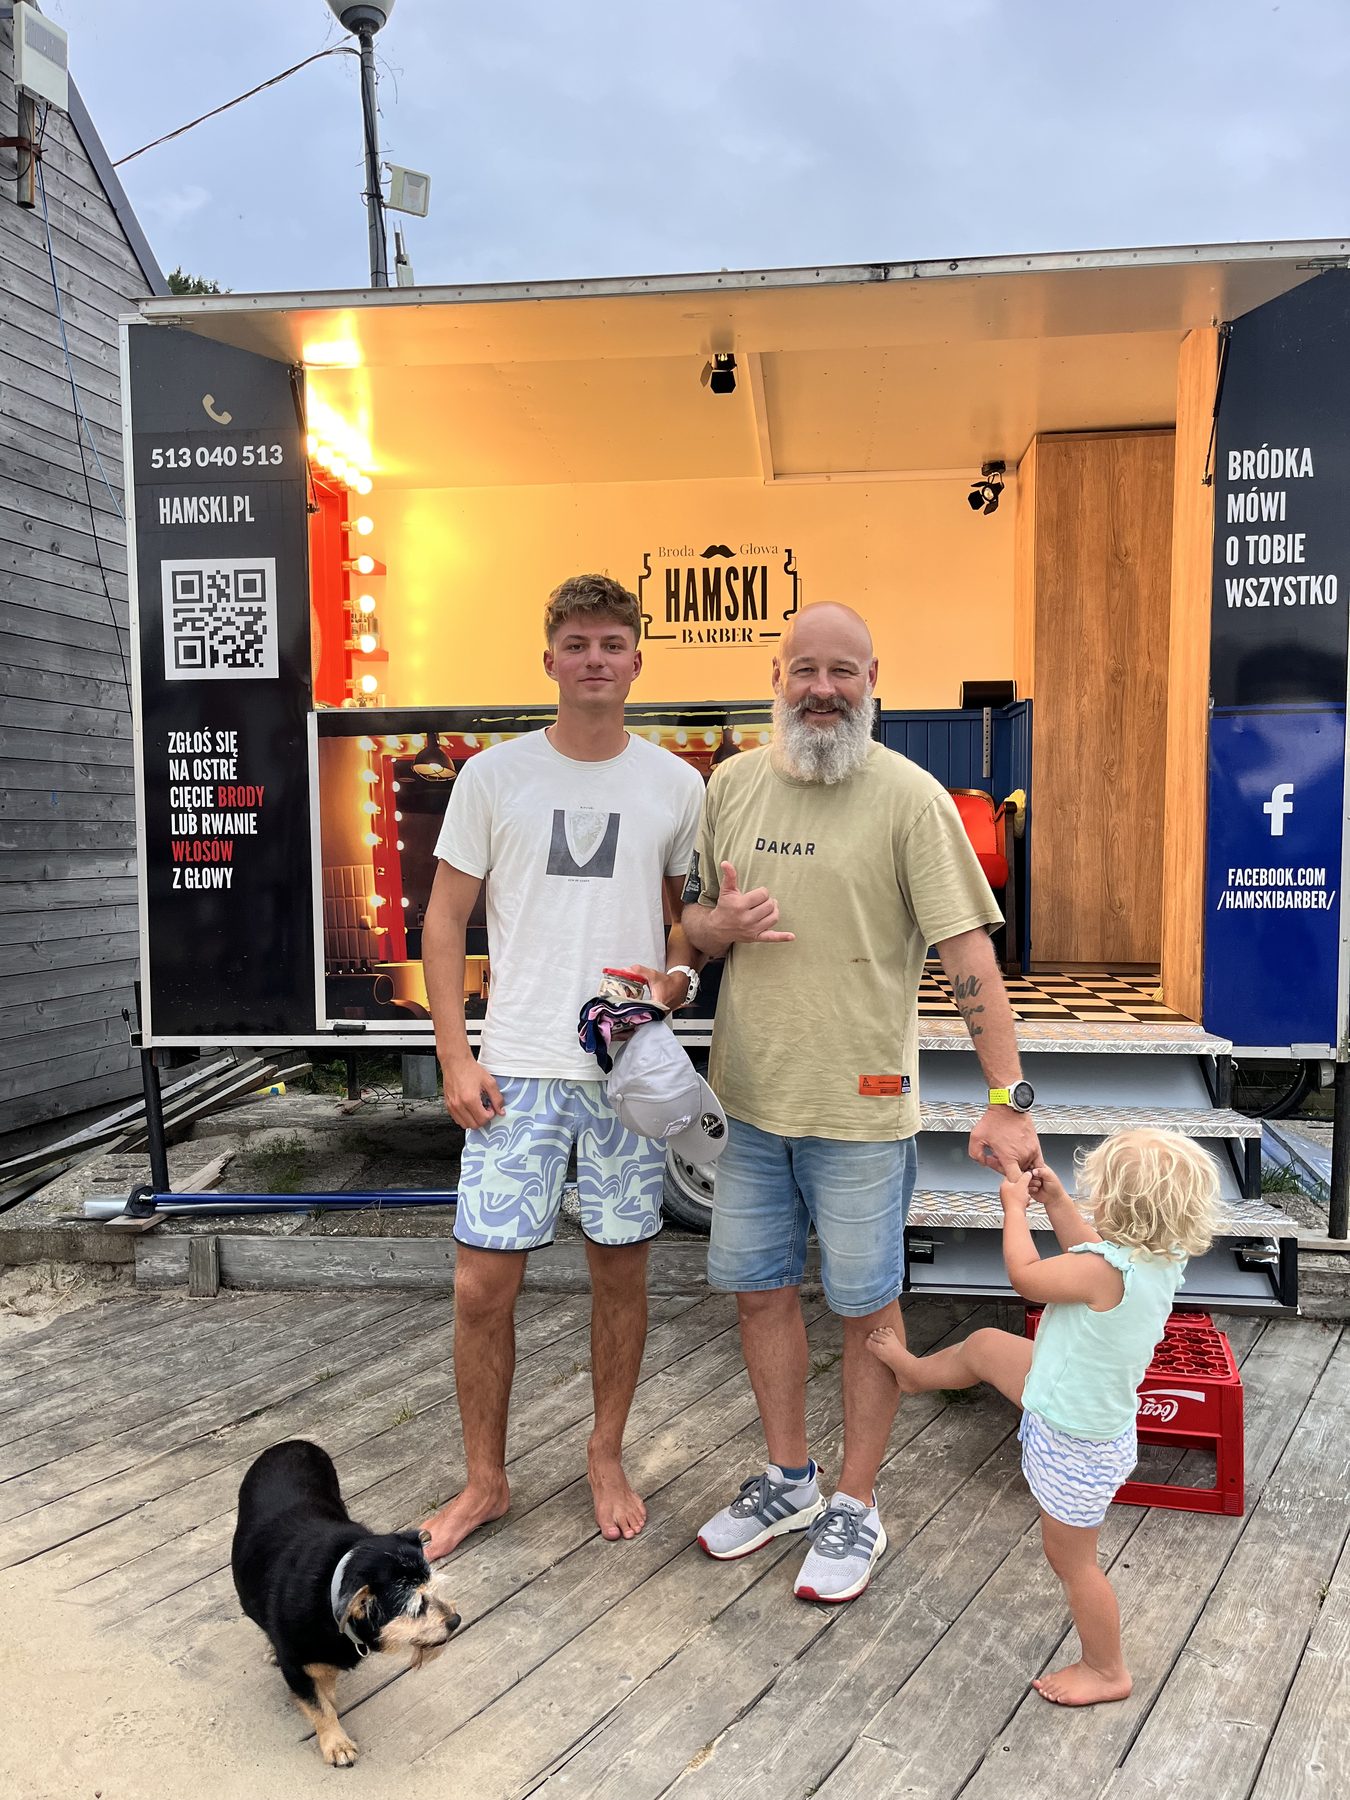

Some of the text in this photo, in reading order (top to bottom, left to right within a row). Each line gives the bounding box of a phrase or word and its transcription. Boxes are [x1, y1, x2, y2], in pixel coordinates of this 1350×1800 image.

[151, 444, 284, 469] 513 040 513
[1228, 443, 1314, 481] BRÓDKA
[159, 495, 255, 524] HAMSKI.PL
[1227, 486, 1287, 524] MÓWI
[658, 544, 695, 558] Broda
[1225, 533, 1306, 566] O TOBIE
[665, 565, 768, 623] HAMSKI
[1225, 574, 1338, 608] WSZYSTKO
[682, 627, 753, 643] BARBER
[168, 726, 239, 758] ZGŁOŚ SIĘ
[169, 758, 238, 781] NA OSTRE
[170, 785, 265, 813] CIĘCIE BRODY
[171, 812, 258, 835] LUB RWANIE
[171, 836, 234, 862] WŁOSÓW
[755, 837, 815, 856] DAKAR
[172, 867, 234, 889] Z GŁOWY
[1228, 867, 1326, 887] FACEBOOK.COM
[1217, 890, 1336, 911] /HAMSKIBARBER/
